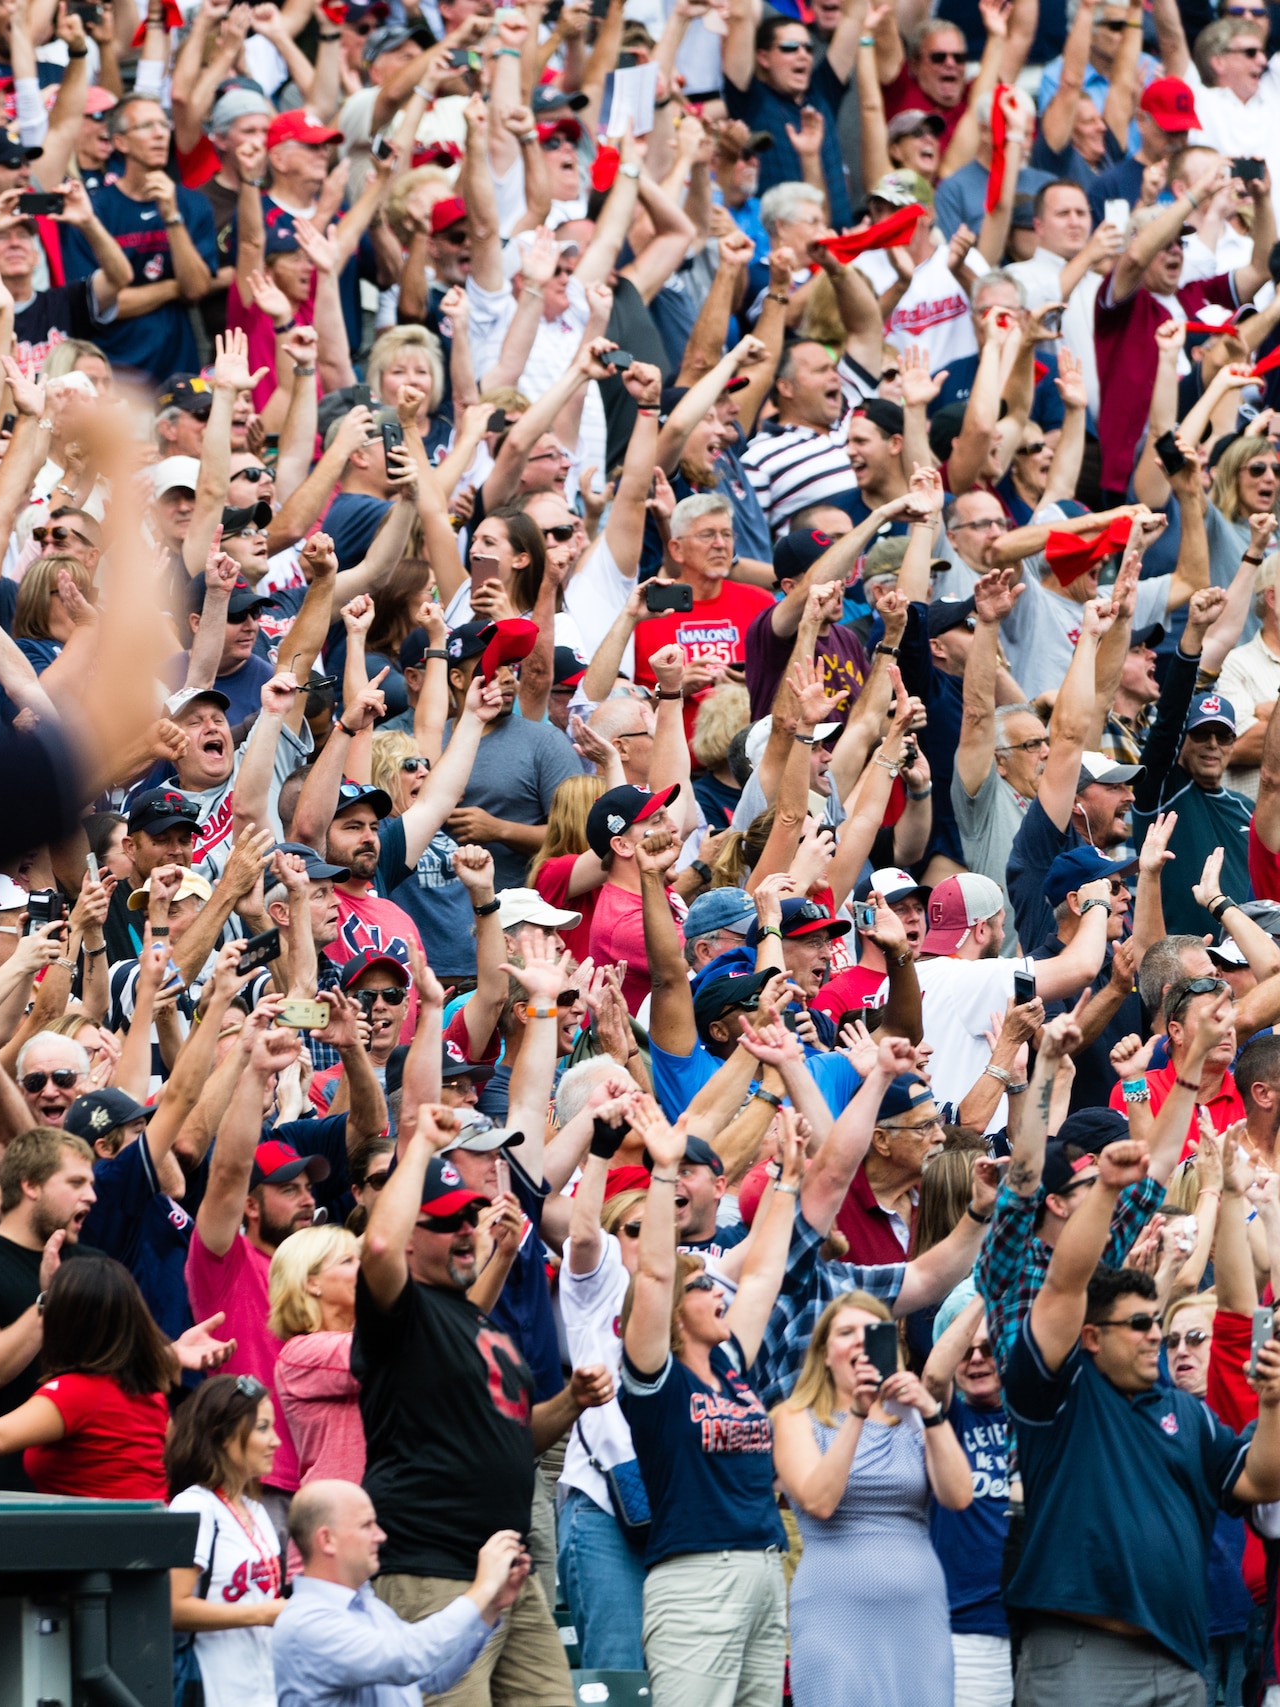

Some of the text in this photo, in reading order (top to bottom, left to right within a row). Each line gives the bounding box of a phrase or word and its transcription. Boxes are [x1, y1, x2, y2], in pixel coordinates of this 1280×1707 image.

[810, 529, 831, 546] C
[680, 627, 736, 644] MALONE
[688, 642, 732, 667] 125
[930, 902, 943, 924] C
[474, 1328, 532, 1427] C
